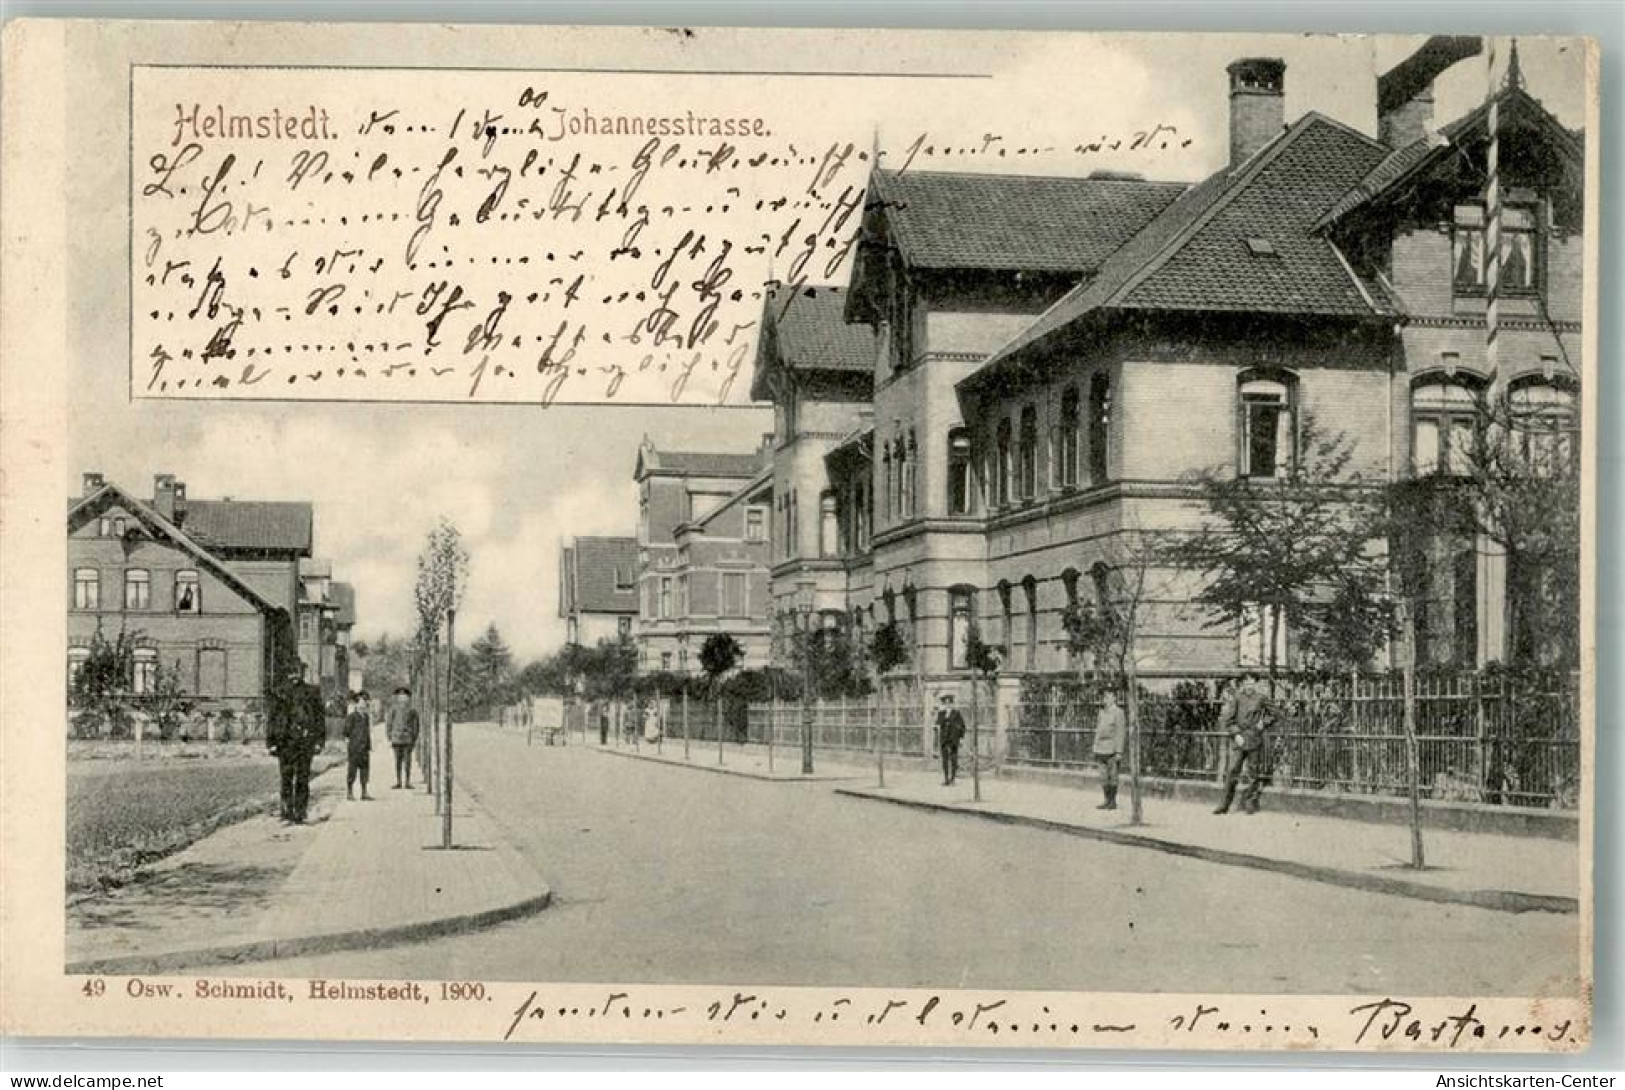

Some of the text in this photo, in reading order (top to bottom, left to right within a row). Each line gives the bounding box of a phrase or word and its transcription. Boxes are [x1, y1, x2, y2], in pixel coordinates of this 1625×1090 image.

[172, 103, 338, 146] Helmstedt.
[548, 107, 772, 141] Johannesstrasse.
[81, 978, 494, 1004] 49 Osw. Schmidt, Helmstedt, 1900.
